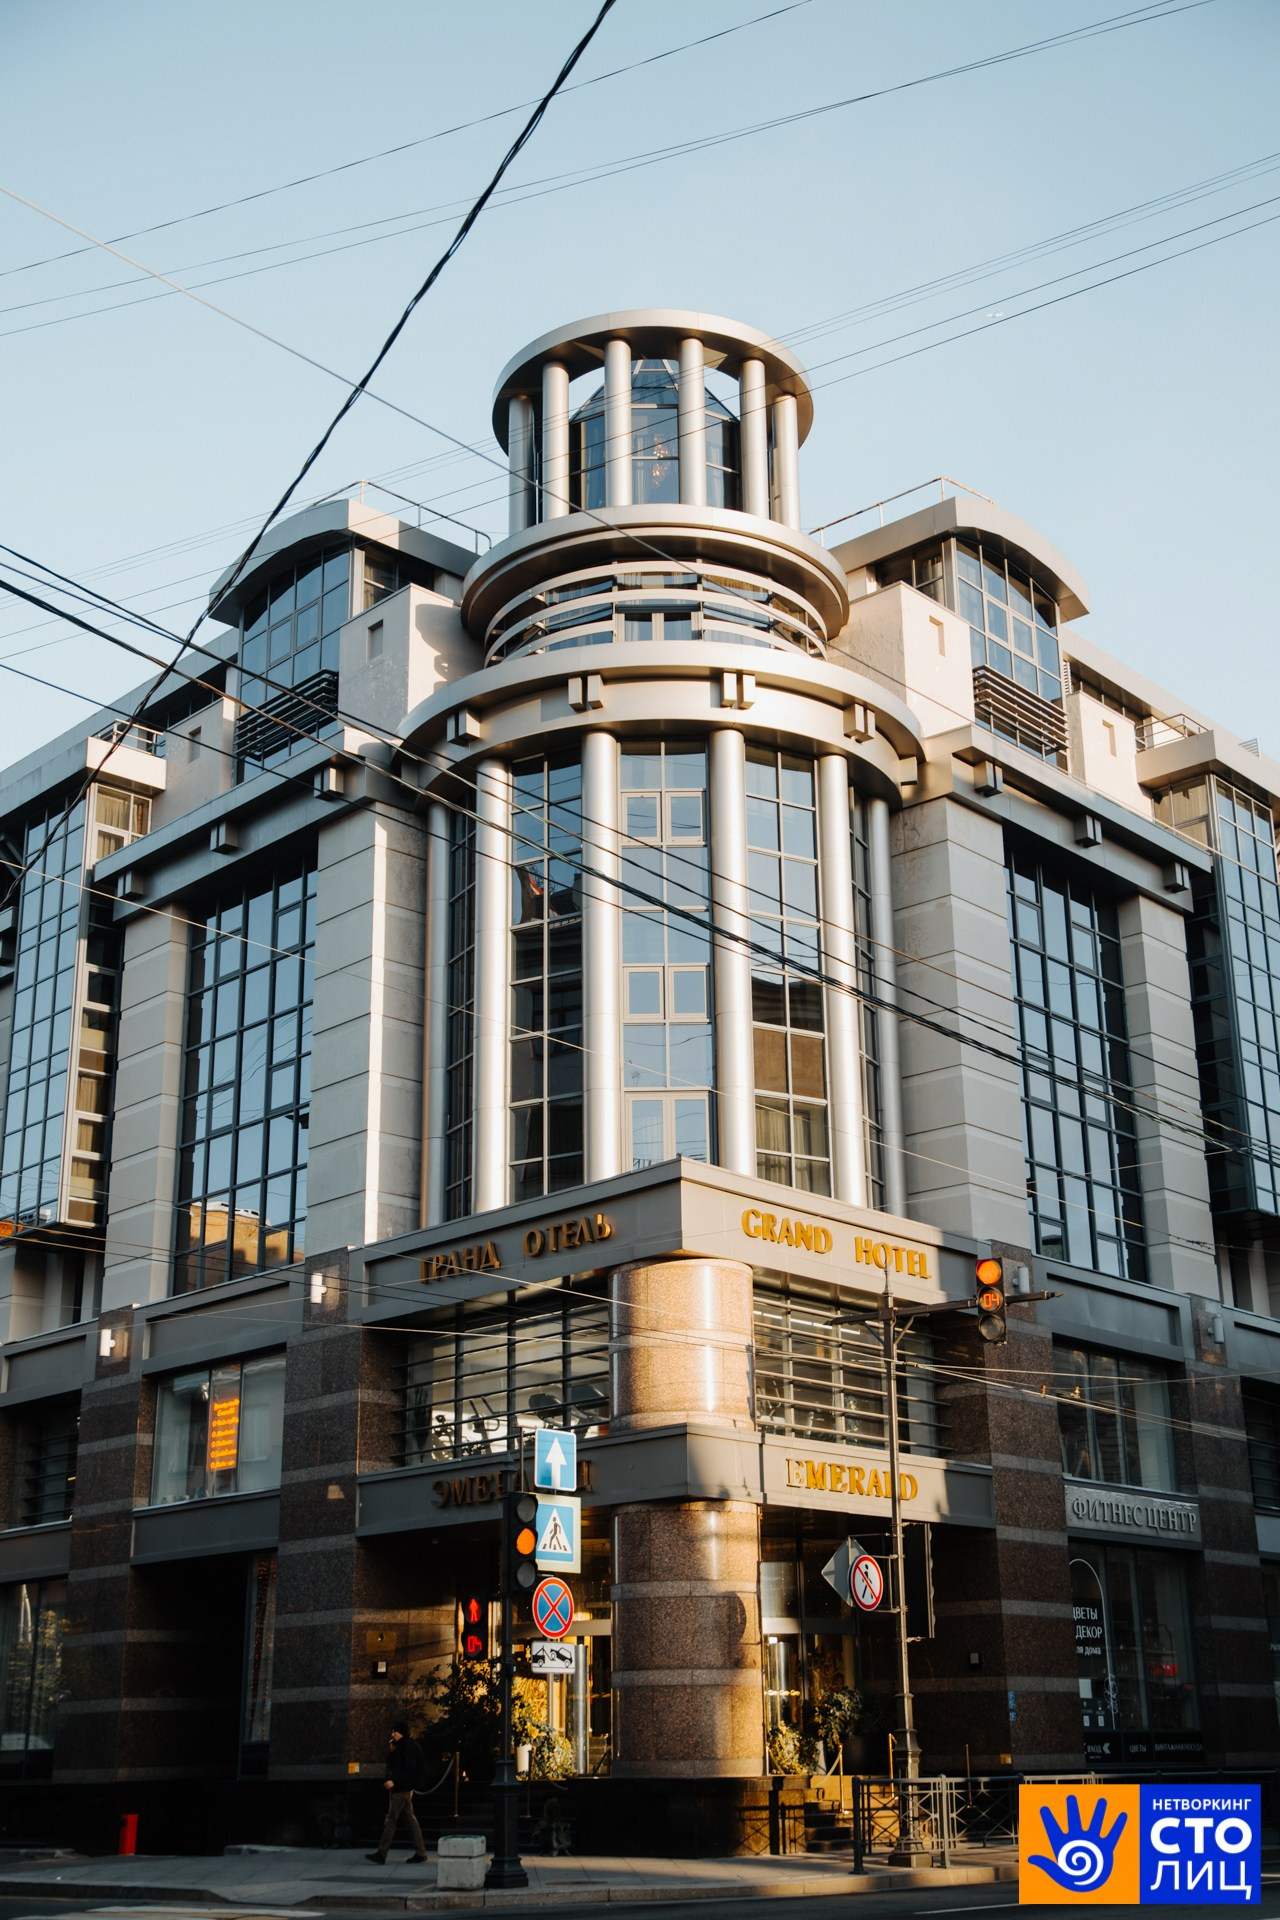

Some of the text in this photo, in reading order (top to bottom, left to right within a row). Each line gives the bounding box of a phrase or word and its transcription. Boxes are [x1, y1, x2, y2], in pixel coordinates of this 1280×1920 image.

[420, 1213, 613, 1284] ГРАНД ОТЕЛЬ
[741, 1208, 931, 1279] GRAND HOTEL
[983, 1293, 1000, 1308] 04
[786, 1458, 918, 1501] EMERALD
[1072, 1498, 1197, 1533] ФИТНЕС ЦЕНТР
[1075, 1625, 1103, 1640] ДЕКОР
[1085, 1646, 1102, 1656] дома
